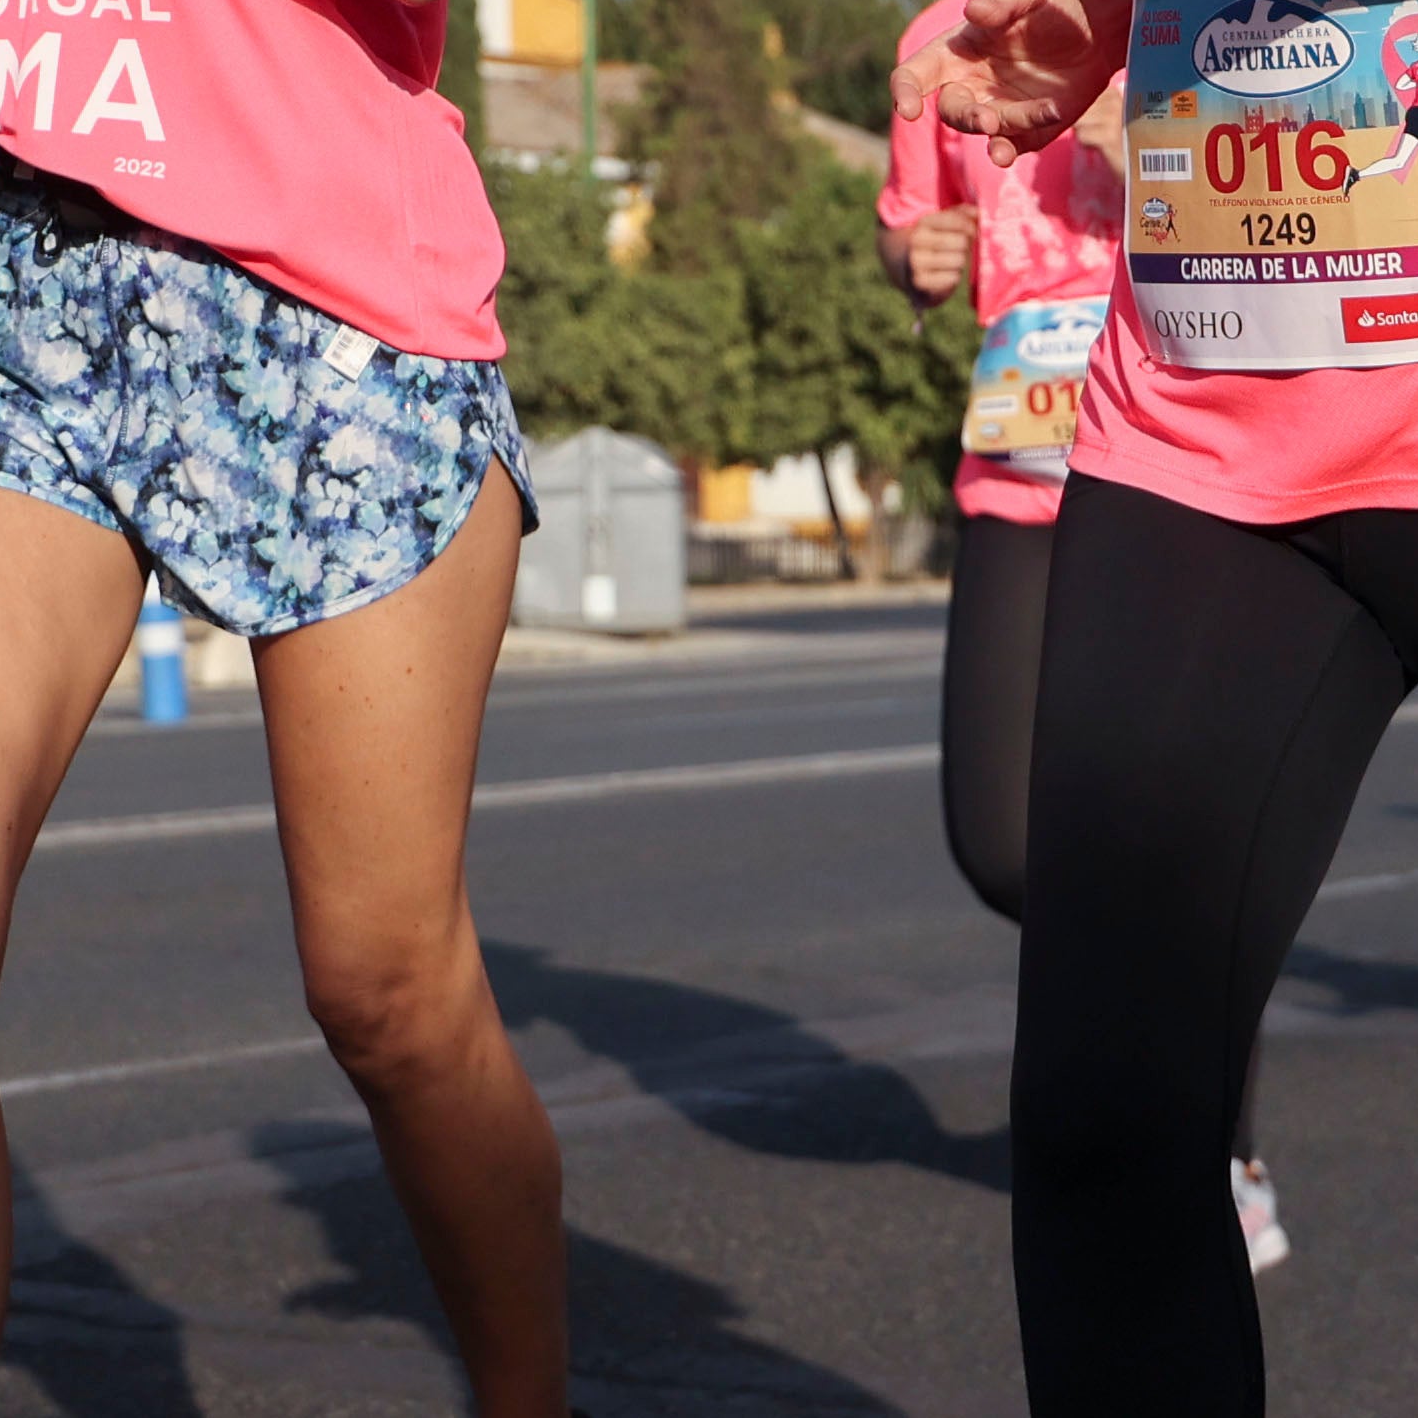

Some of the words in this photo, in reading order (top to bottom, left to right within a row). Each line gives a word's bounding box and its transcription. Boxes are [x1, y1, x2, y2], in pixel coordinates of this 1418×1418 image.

[1140, 25, 1181, 47] SUMA
[1222, 30, 1269, 42] CENTRAL
[1272, 27, 1330, 40] LECHERA
[1202, 33, 1340, 73] ASTURIANA
[113, 157, 166, 179] 2022
[1204, 119, 1351, 194] 016
[1209, 196, 1248, 207] TELÉFONO
[1249, 196, 1294, 207] VIOLENCIA
[1295, 196, 1309, 206] DE
[1240, 212, 1317, 246] 1249
[1181, 256, 1257, 280] CARRERA
[1261, 256, 1287, 280] DE
[1292, 256, 1319, 279] LA
[1325, 252, 1404, 278] MUJER
[1154, 310, 1243, 340] OYSHO
